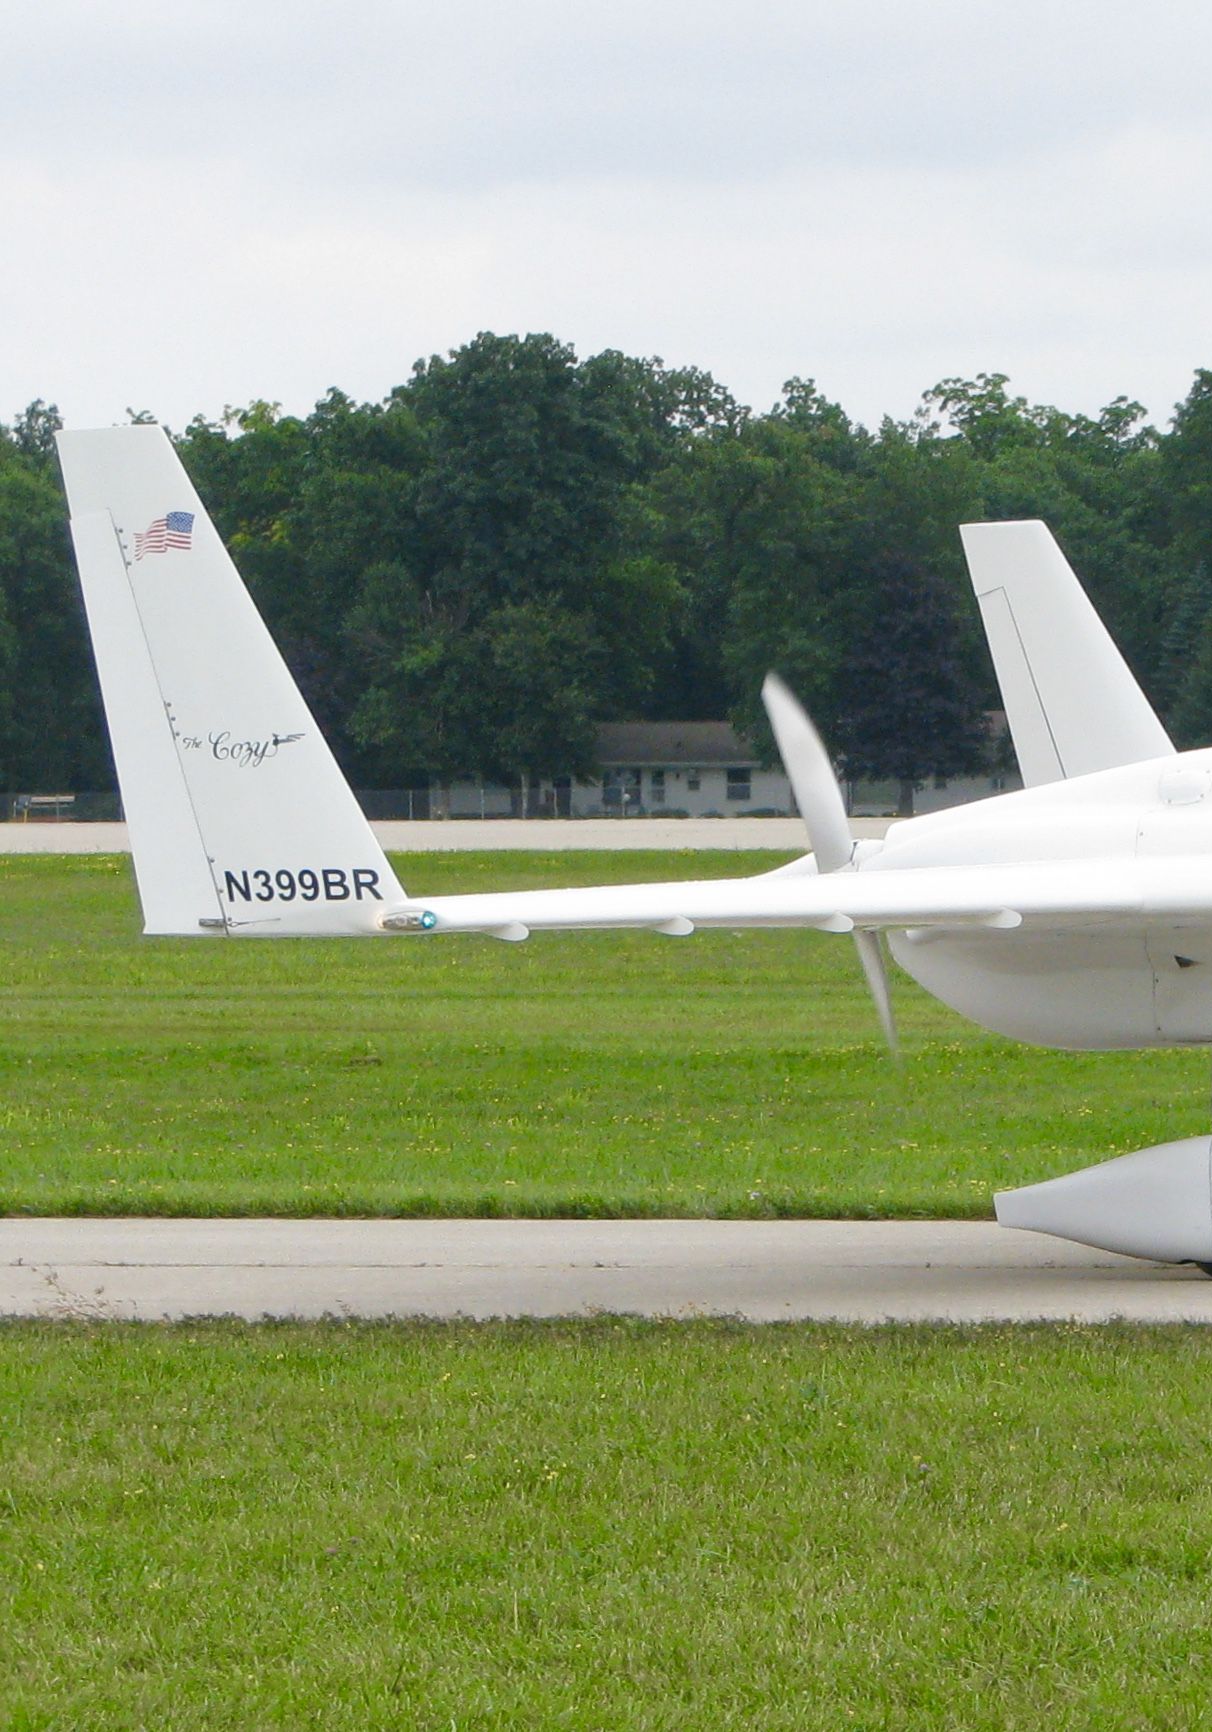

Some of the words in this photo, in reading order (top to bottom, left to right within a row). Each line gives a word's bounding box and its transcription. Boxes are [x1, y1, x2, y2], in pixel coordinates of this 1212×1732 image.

[182, 737, 202, 749] The
[208, 731, 275, 768] Cozy
[224, 868, 384, 902] N399BR
